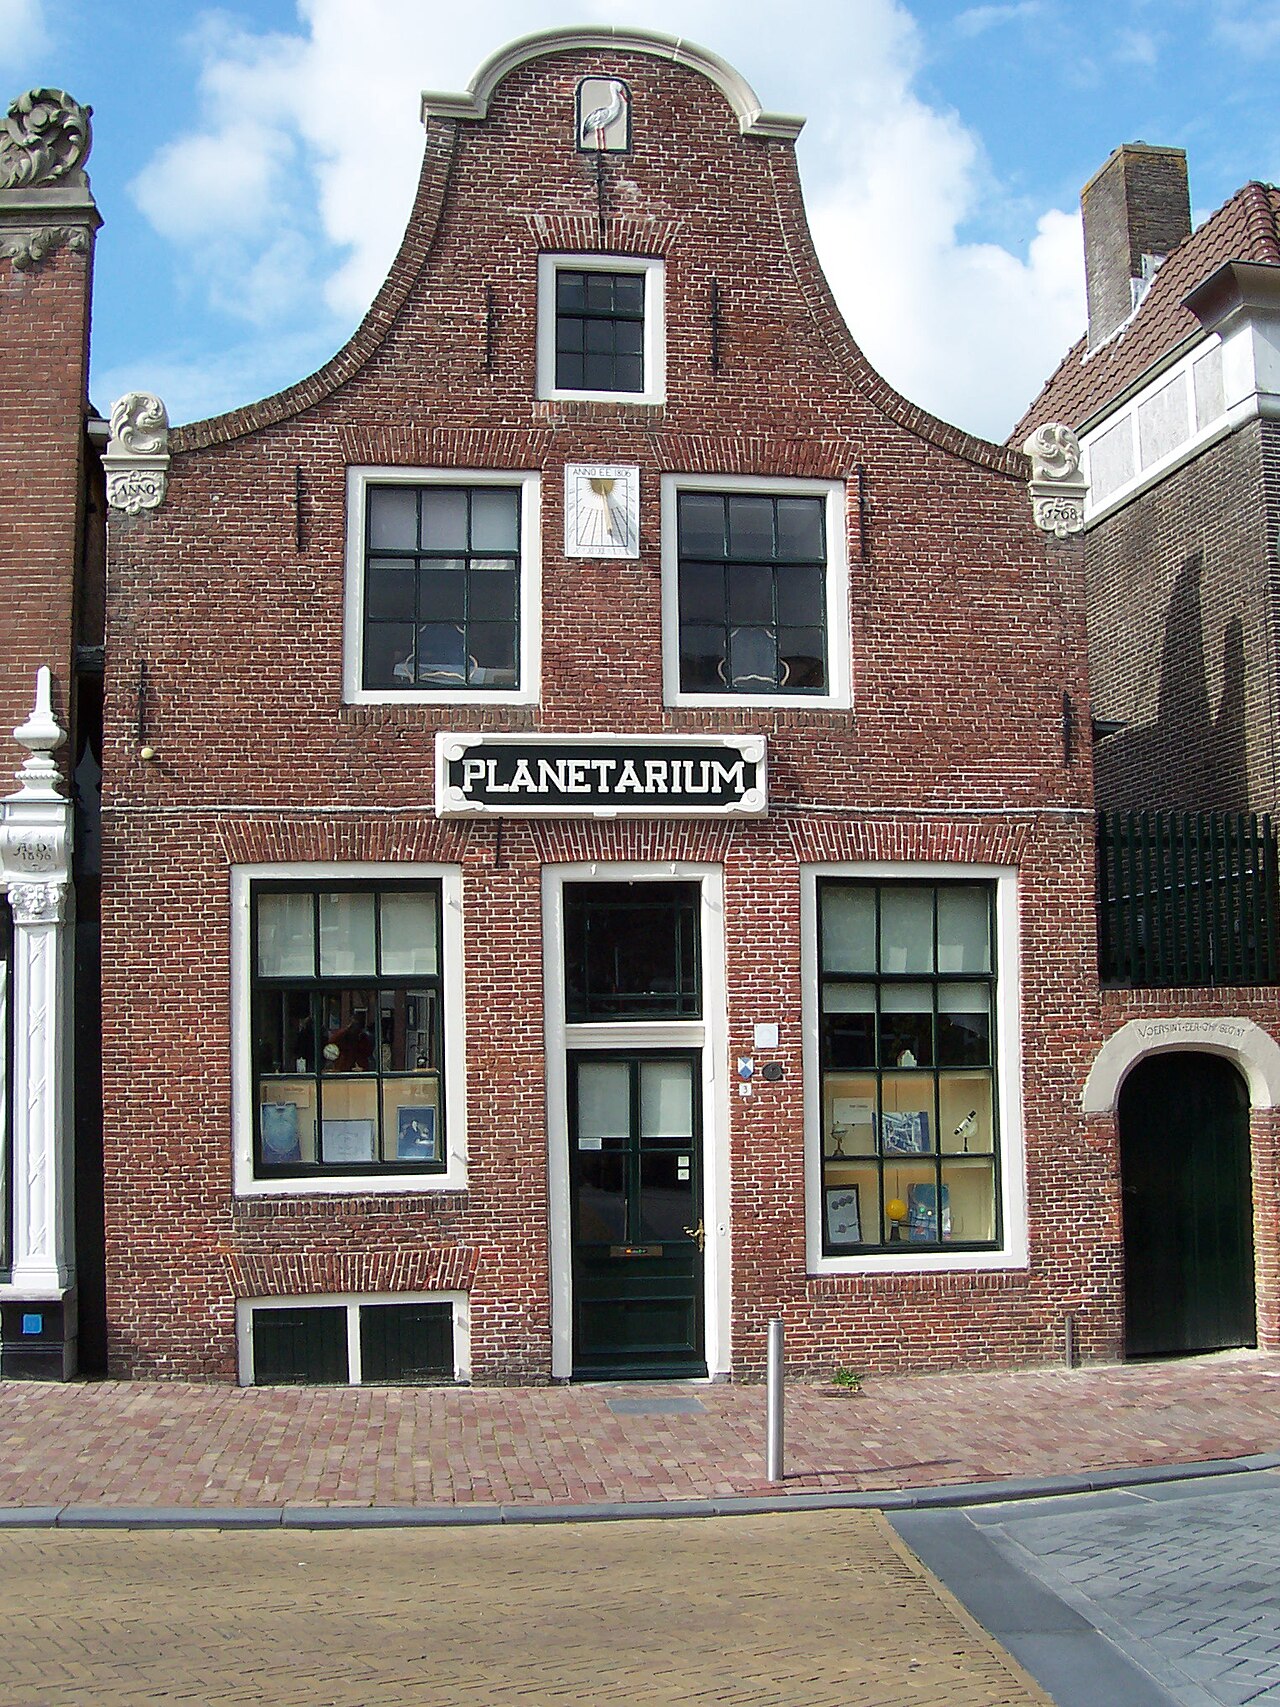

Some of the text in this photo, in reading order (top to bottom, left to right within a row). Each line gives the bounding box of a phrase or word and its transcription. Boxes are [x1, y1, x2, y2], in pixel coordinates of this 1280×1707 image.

[573, 468, 597, 477] ANNO
[614, 469, 632, 478] 1806
[117, 484, 155, 496] ANNO
[1045, 508, 1078, 520] 1768
[462, 759, 746, 794] PLANETARIUM
[22, 852, 52, 861] 1896
[742, 1085, 748, 1094] 3
